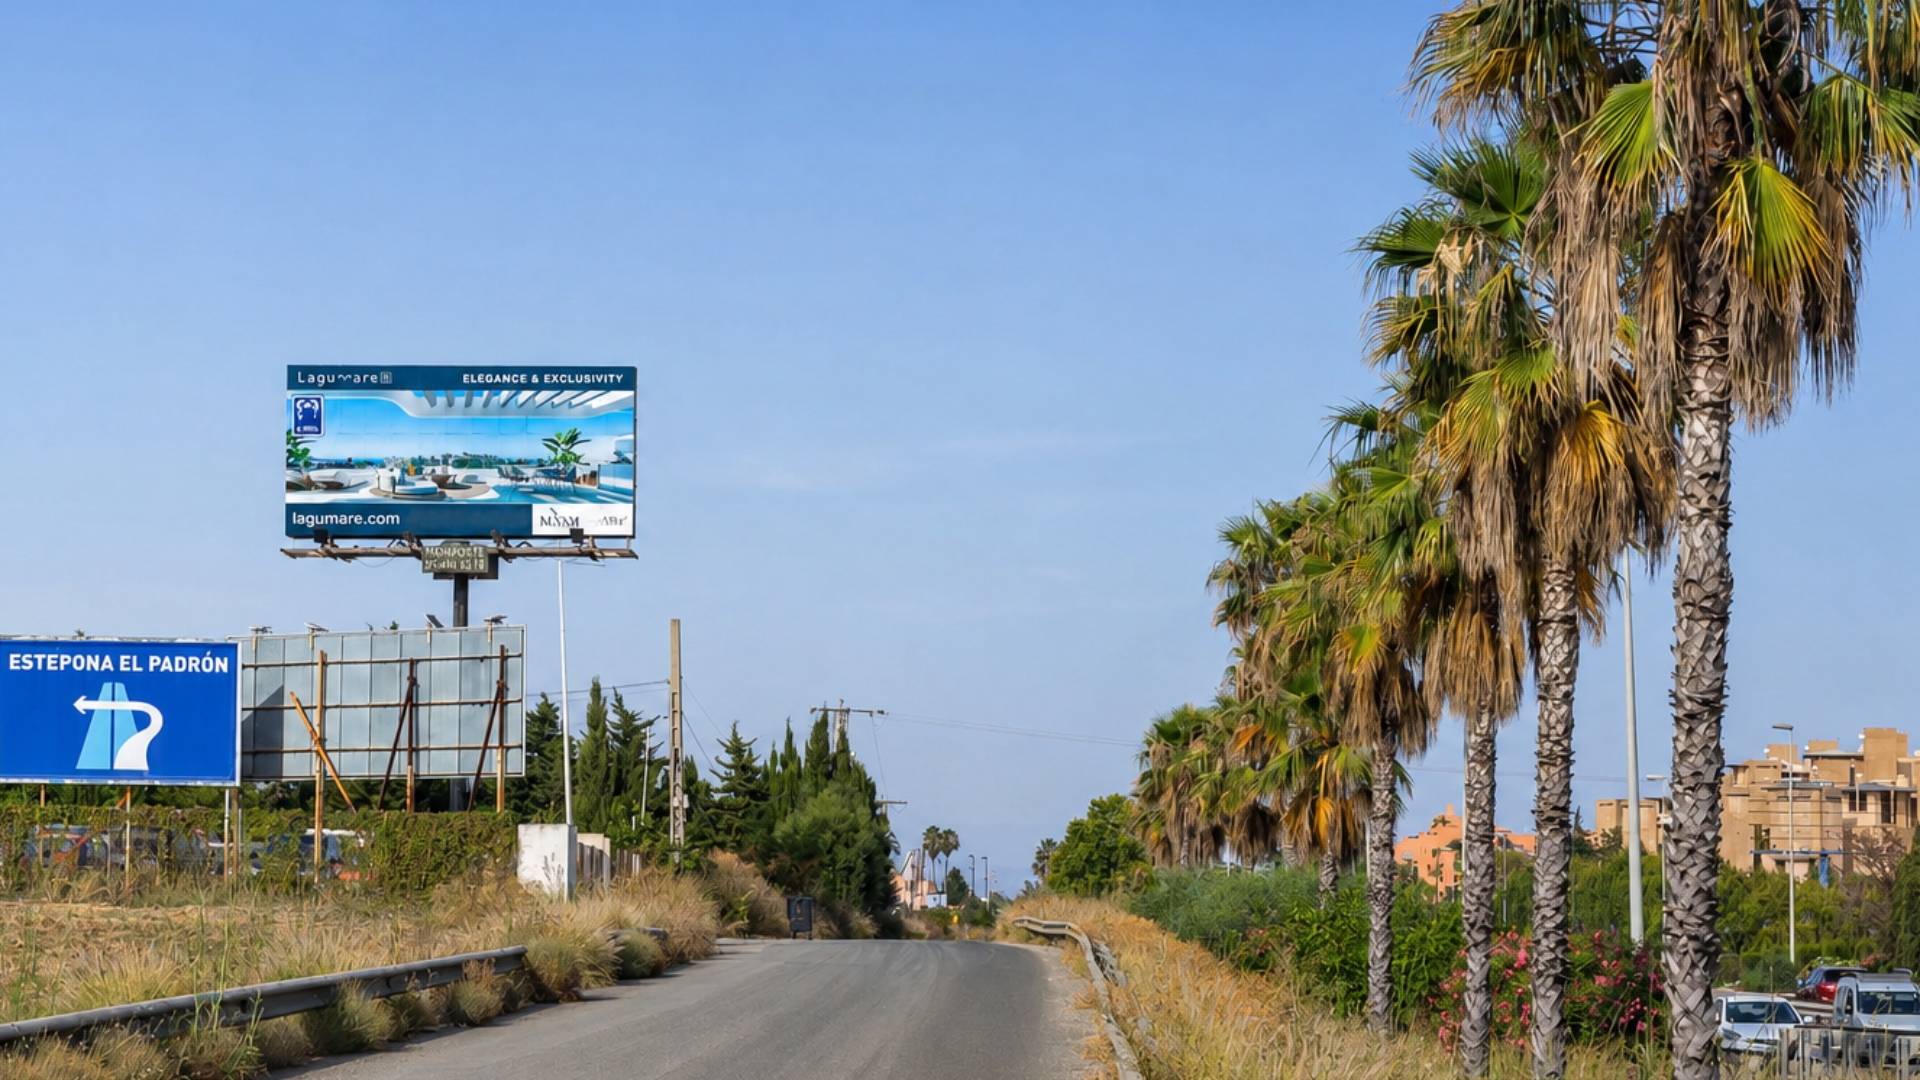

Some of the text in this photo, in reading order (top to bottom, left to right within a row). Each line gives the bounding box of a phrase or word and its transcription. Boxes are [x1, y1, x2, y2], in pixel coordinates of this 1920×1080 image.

[462, 373, 624, 384] ELEGANCE & EXCLUSIVITY
[292, 511, 401, 528] lagumare.com
[9, 651, 228, 673] ESTEPONA EL PADRÓN
